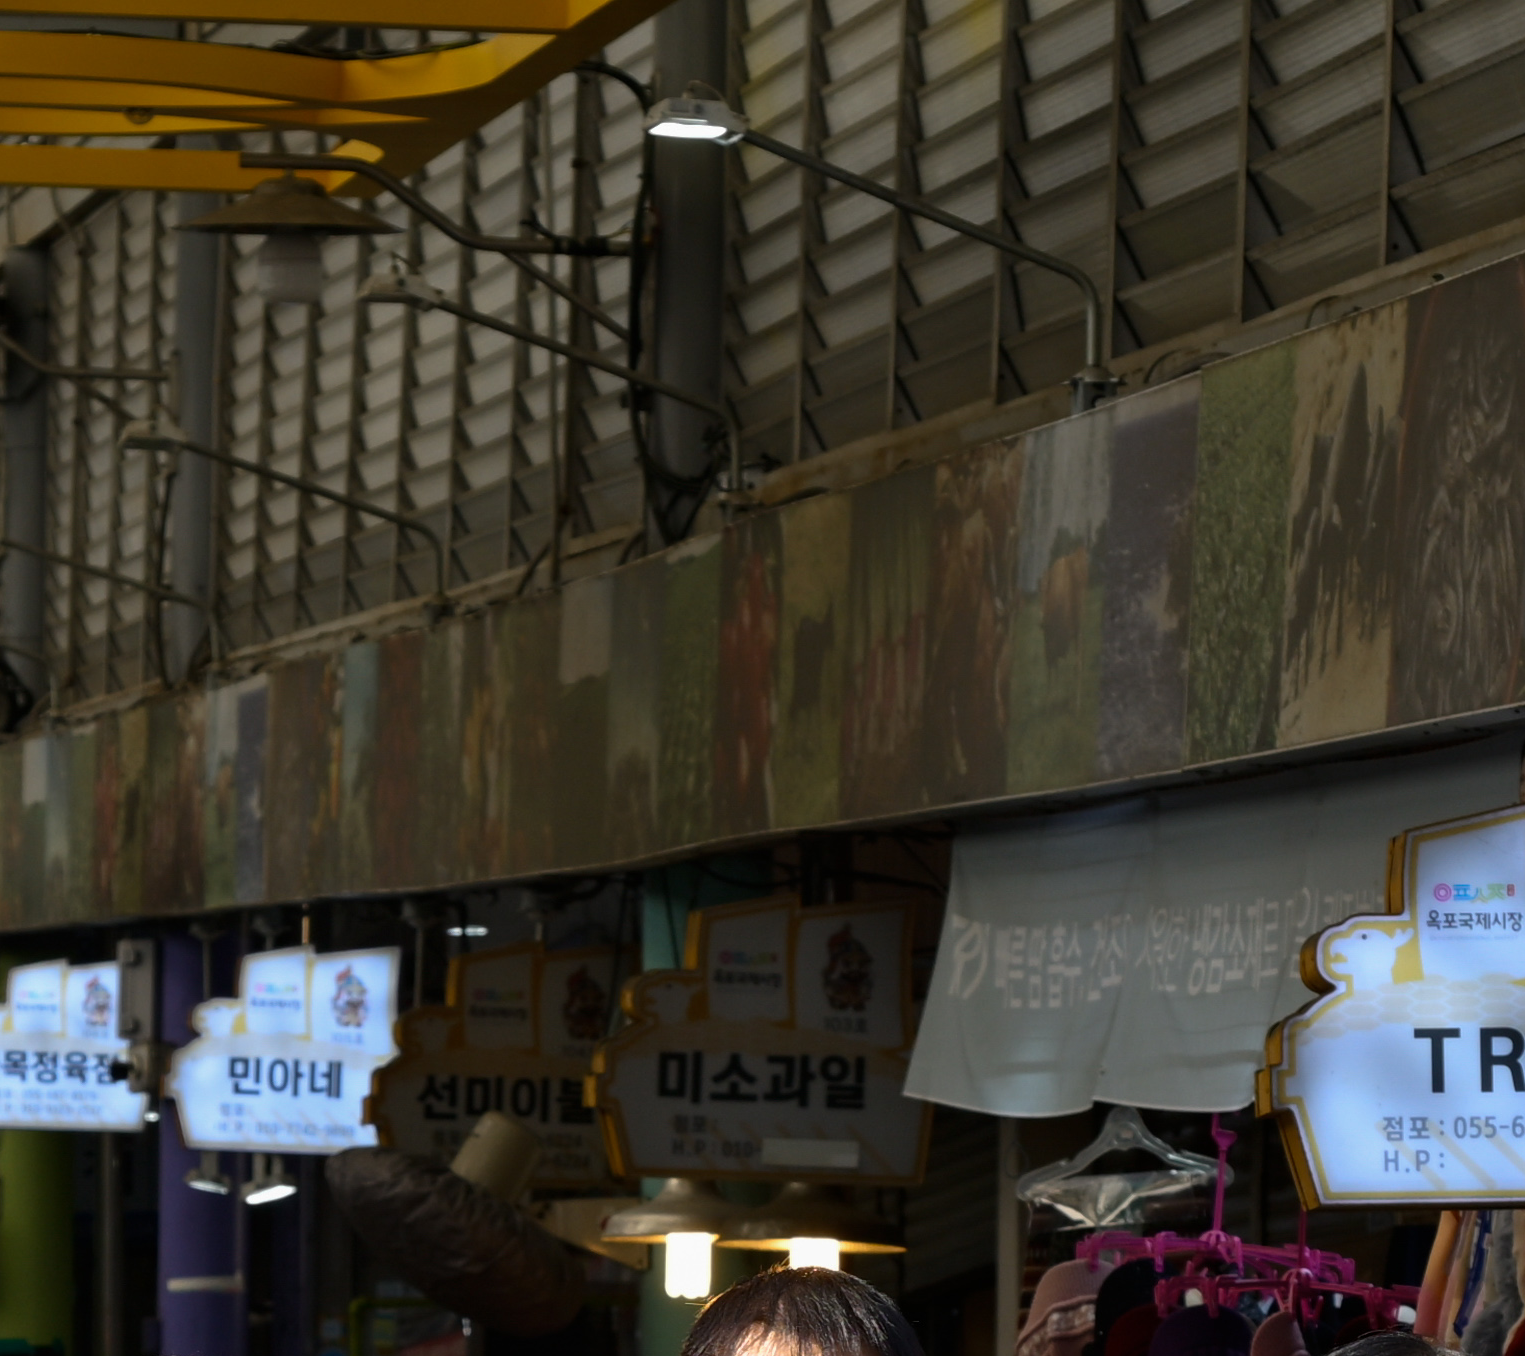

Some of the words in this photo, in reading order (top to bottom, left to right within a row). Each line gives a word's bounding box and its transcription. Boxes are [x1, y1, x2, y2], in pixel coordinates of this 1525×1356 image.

[1425, 909, 1524, 932] 옥포국제시장
[228, 1055, 345, 1100] 민아네
[657, 1050, 867, 1112] 미소과일
